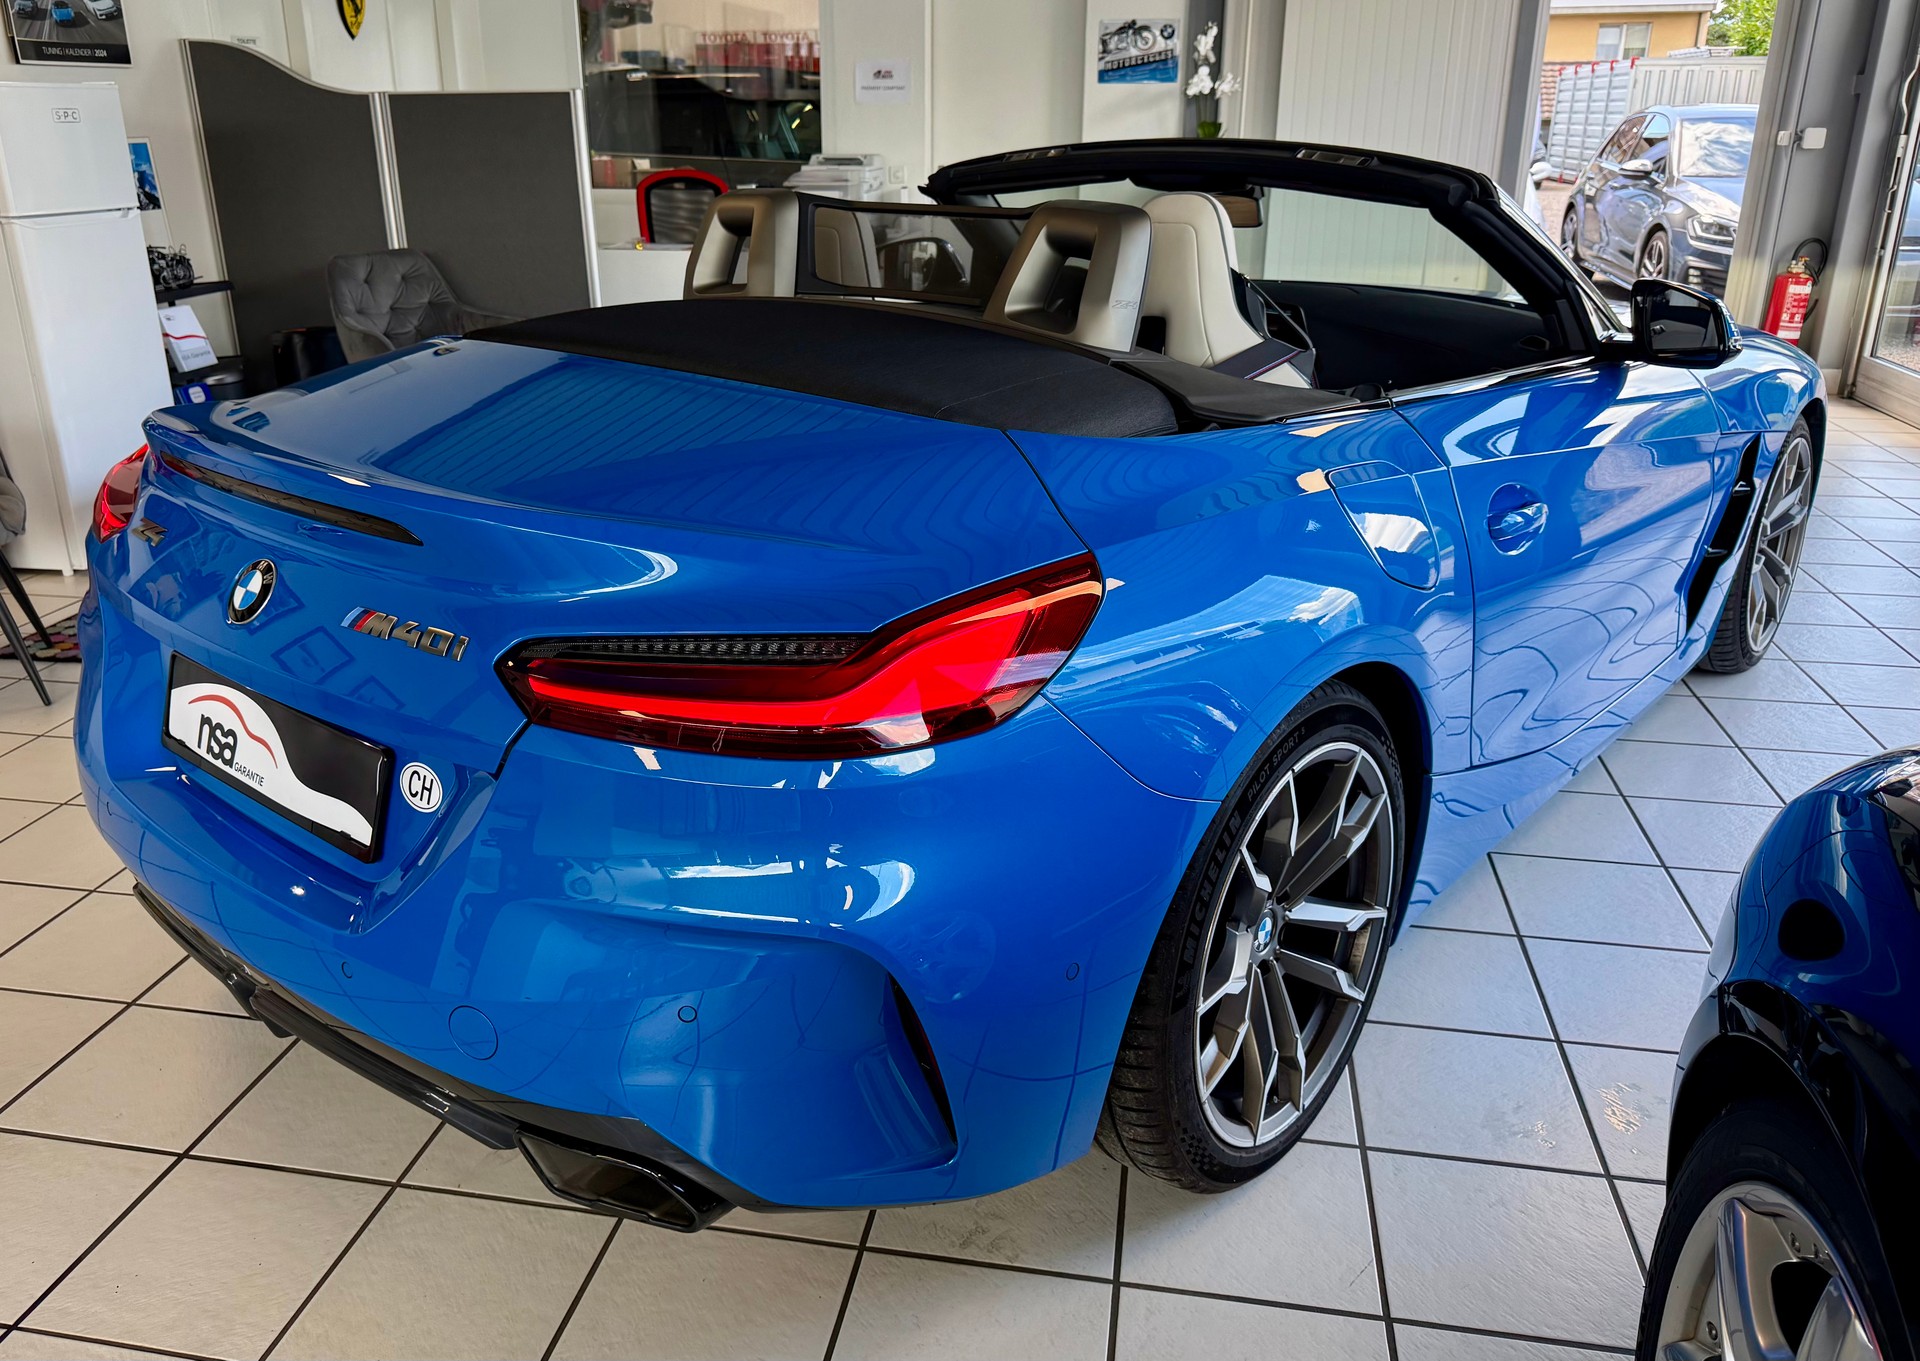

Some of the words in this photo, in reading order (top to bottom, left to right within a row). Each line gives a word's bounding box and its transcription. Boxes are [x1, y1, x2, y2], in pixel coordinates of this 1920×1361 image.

[42, 46, 62, 55] TUNING
[65, 48, 92, 57] KALENDER
[94, 49, 108, 57] 2024
[1104, 50, 1172, 71] MOTORCYCLES
[132, 517, 168, 547] Z4
[358, 611, 470, 662] M40i
[197, 713, 238, 769] nsa
[234, 761, 265, 787] GARANTIE
[1247, 762, 1270, 802] PILOT
[1272, 731, 1299, 766] SPORT
[408, 769, 434, 806] CH
[1183, 809, 1242, 965] MICHELIN
